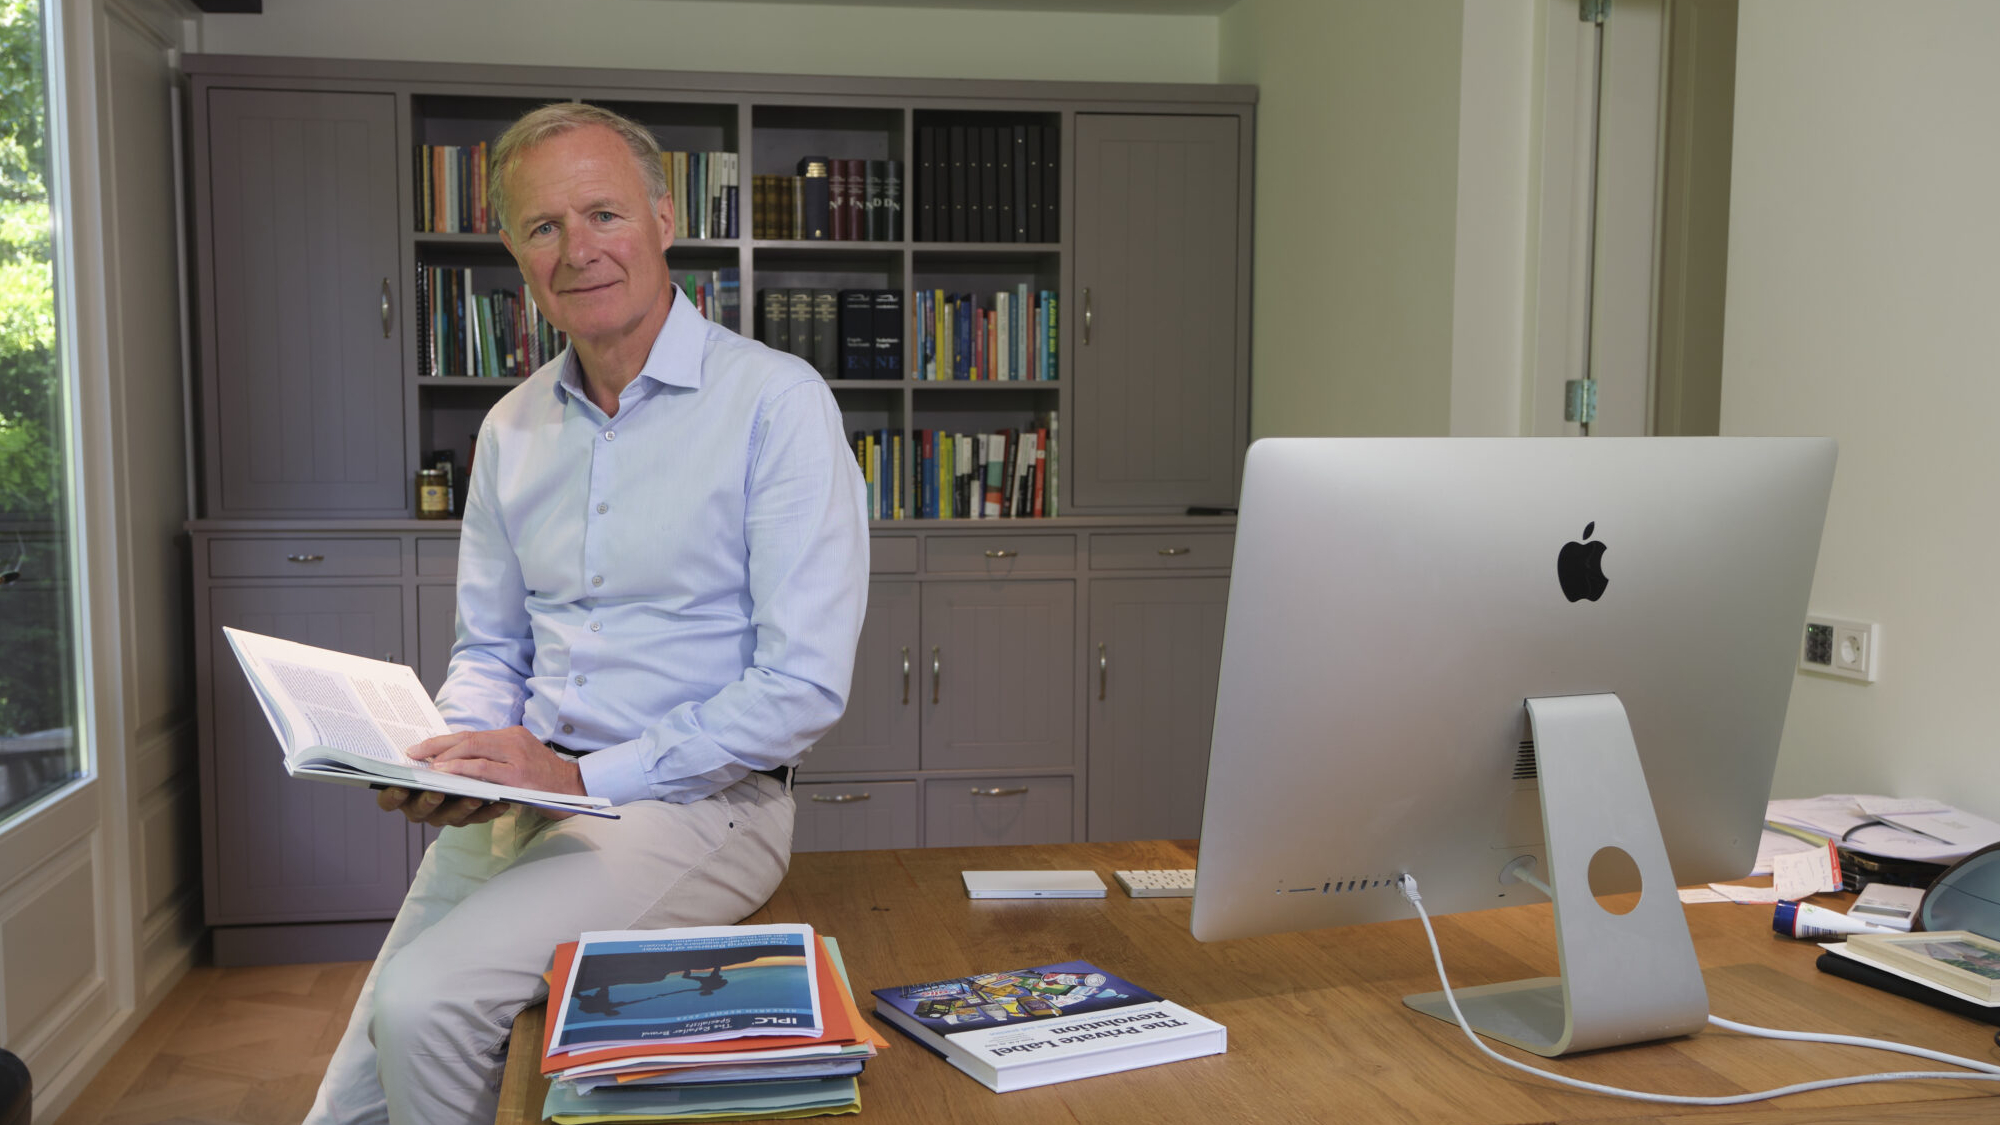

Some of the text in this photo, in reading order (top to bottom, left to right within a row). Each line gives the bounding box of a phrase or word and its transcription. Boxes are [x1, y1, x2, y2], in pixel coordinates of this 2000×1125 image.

[876, 355, 899, 369] NE
[704, 1009, 742, 1018] REPORT
[685, 1017, 731, 1027] Specialists
[754, 1017, 797, 1025] IPLC
[1049, 1011, 1171, 1034] Revolution
[641, 1030, 670, 1038] Brand
[673, 1026, 711, 1034] Retailer
[989, 1019, 1189, 1056] The Private Label
